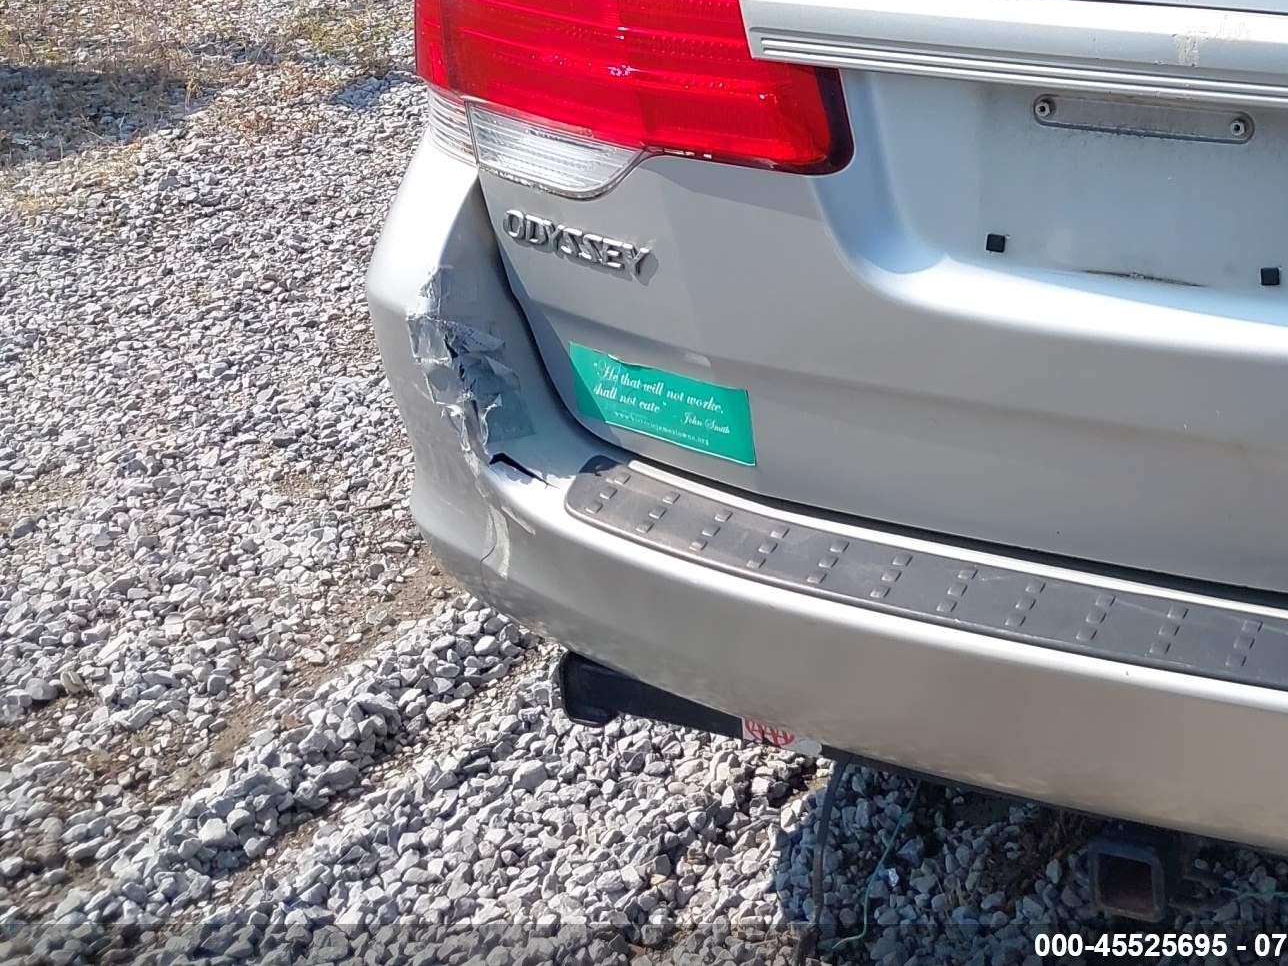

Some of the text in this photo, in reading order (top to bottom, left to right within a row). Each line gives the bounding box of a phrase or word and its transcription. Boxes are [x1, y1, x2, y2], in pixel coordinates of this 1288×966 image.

[503, 209, 650, 275] ODYSSEY
[619, 391, 637, 406] not
[620, 371, 642, 389] that
[643, 382, 664, 396] will
[666, 389, 685, 402] not
[680, 411, 731, 435] John Smith
